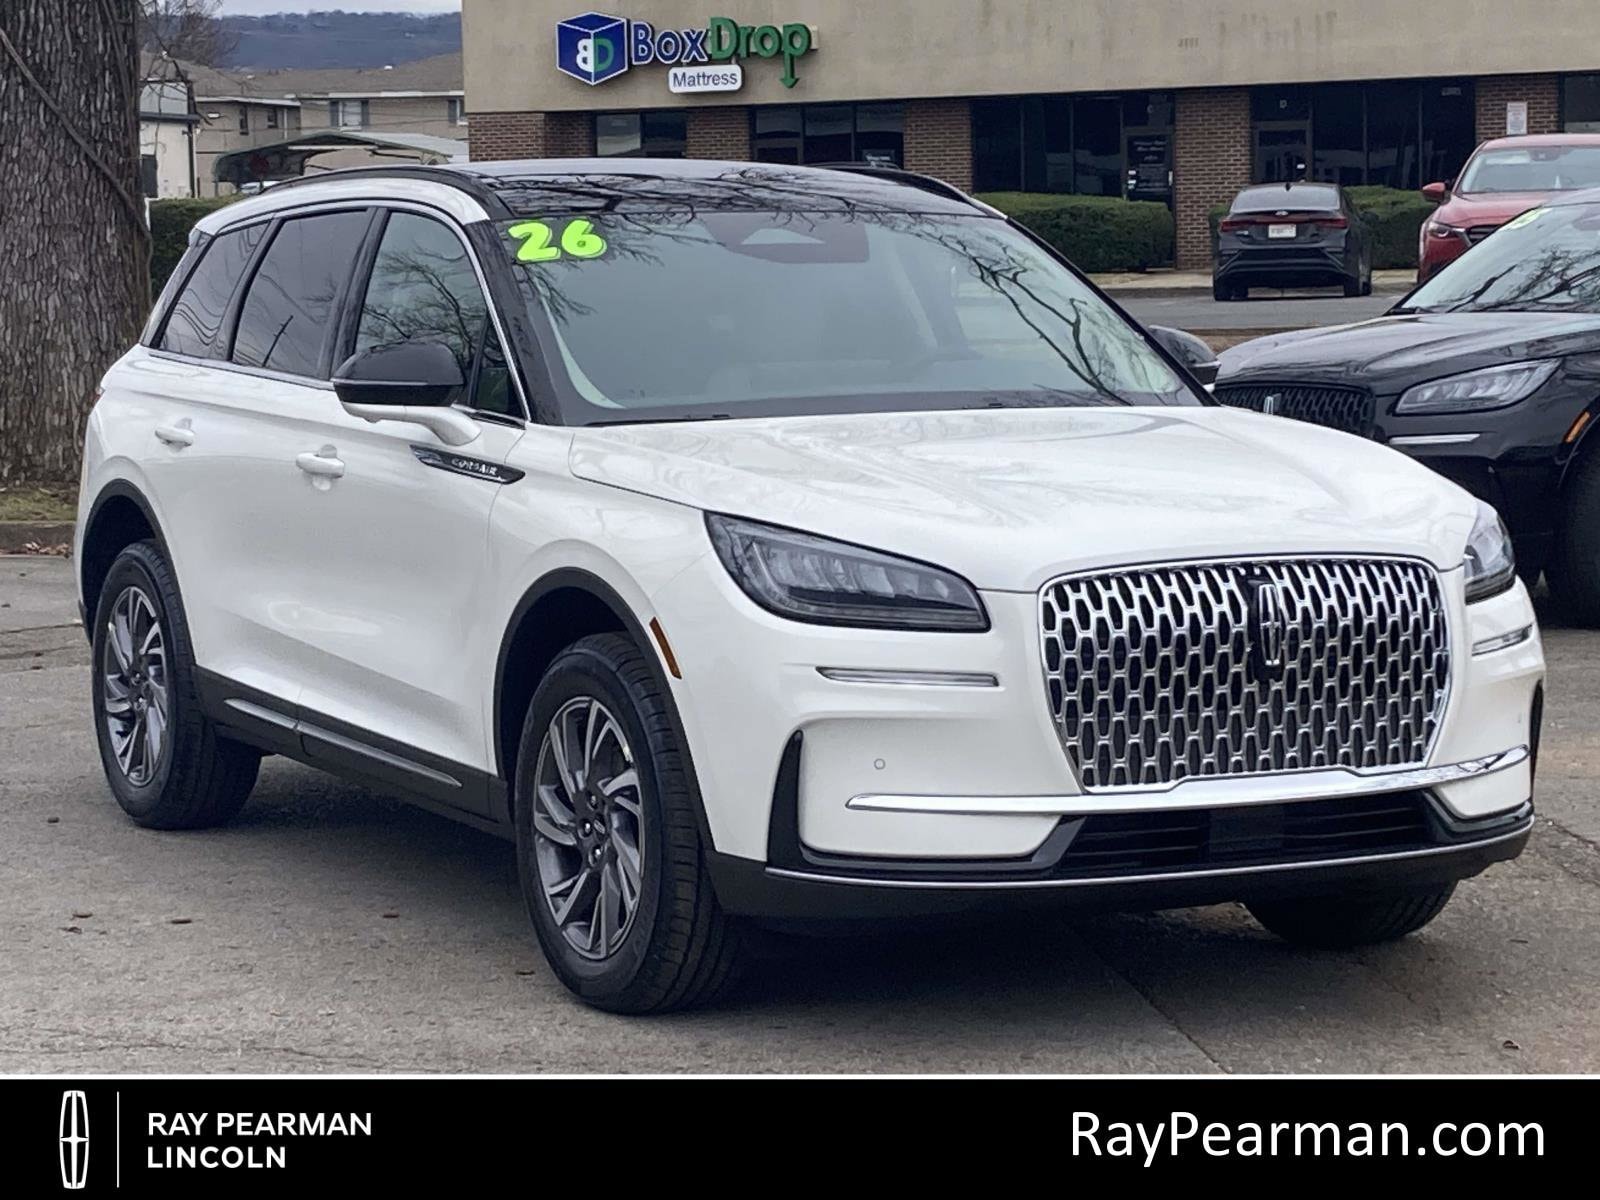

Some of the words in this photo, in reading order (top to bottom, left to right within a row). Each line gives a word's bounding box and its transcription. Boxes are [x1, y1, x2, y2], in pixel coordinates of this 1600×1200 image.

[631, 17, 812, 88] BoxDrop
[672, 70, 738, 88] Mattress
[507, 218, 607, 261] 26
